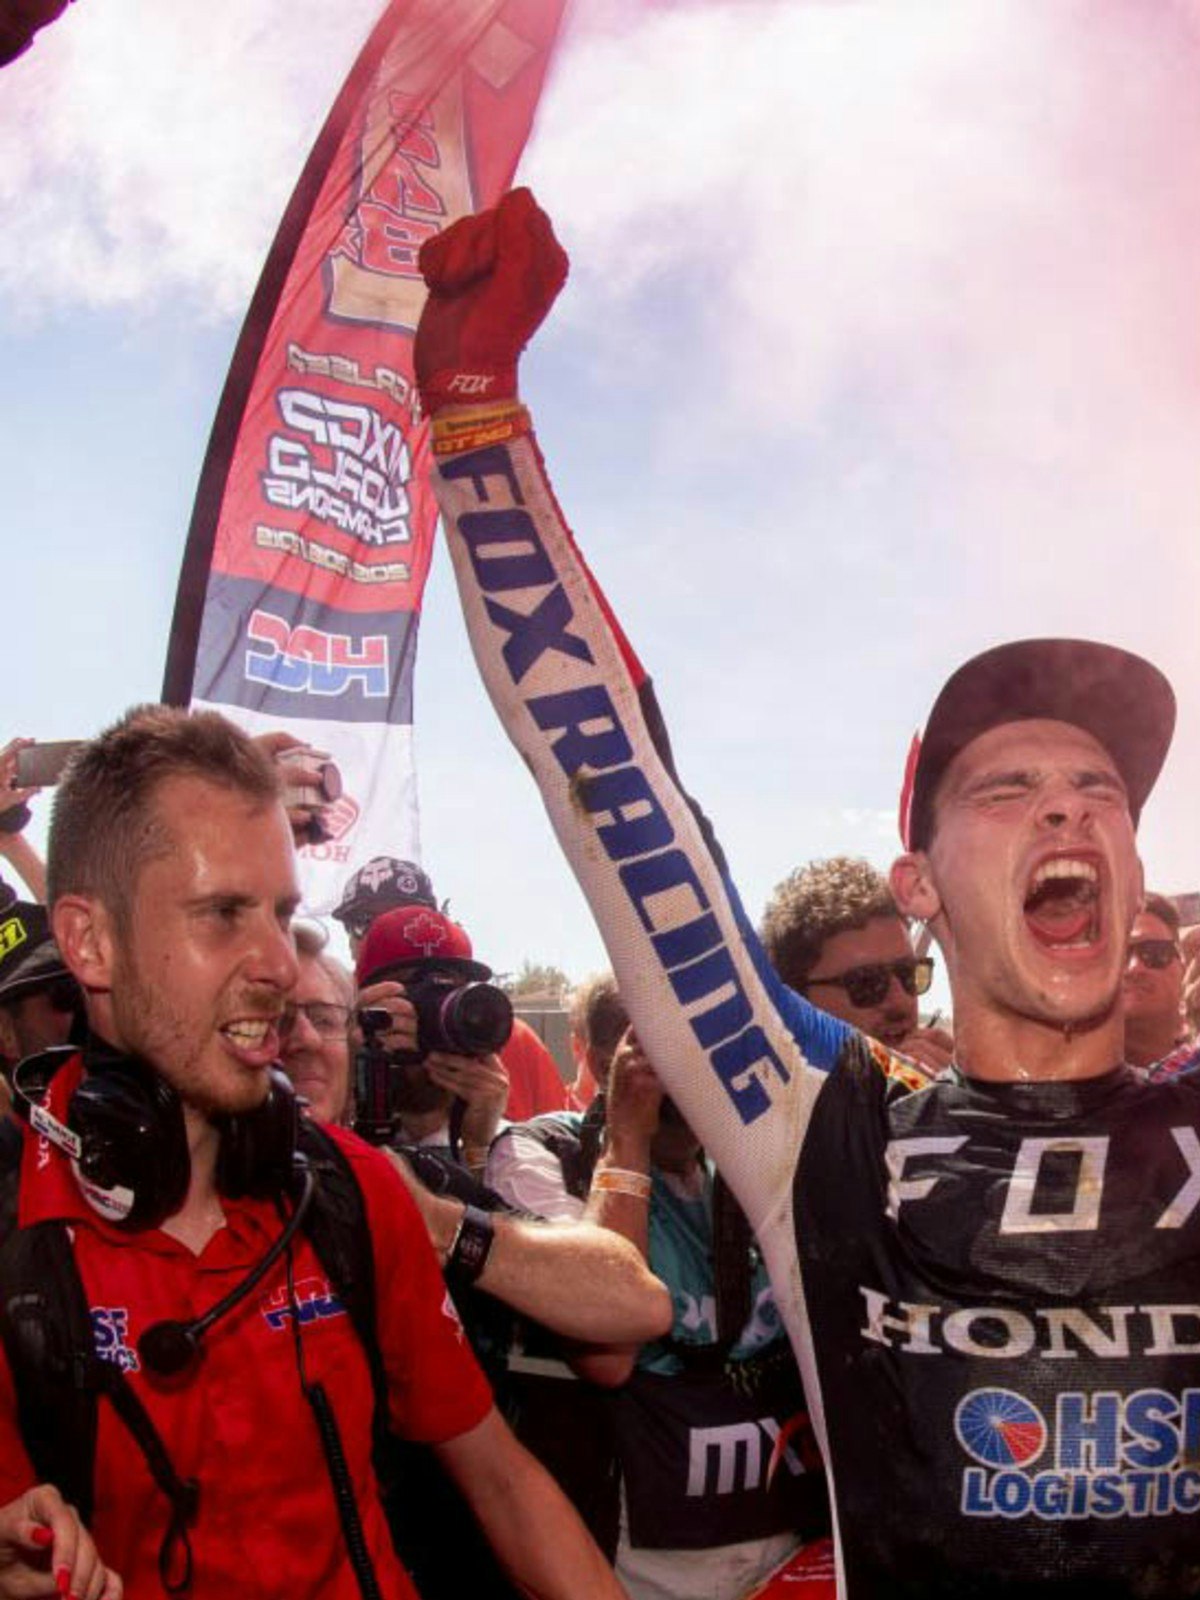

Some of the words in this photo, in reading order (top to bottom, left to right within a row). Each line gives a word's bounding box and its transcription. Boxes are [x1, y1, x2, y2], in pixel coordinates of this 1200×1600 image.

[447, 374, 496, 396] FOX
[438, 444, 596, 686] FOX
[526, 684, 792, 1126] RACING
[90, 1306, 129, 1348] SF
